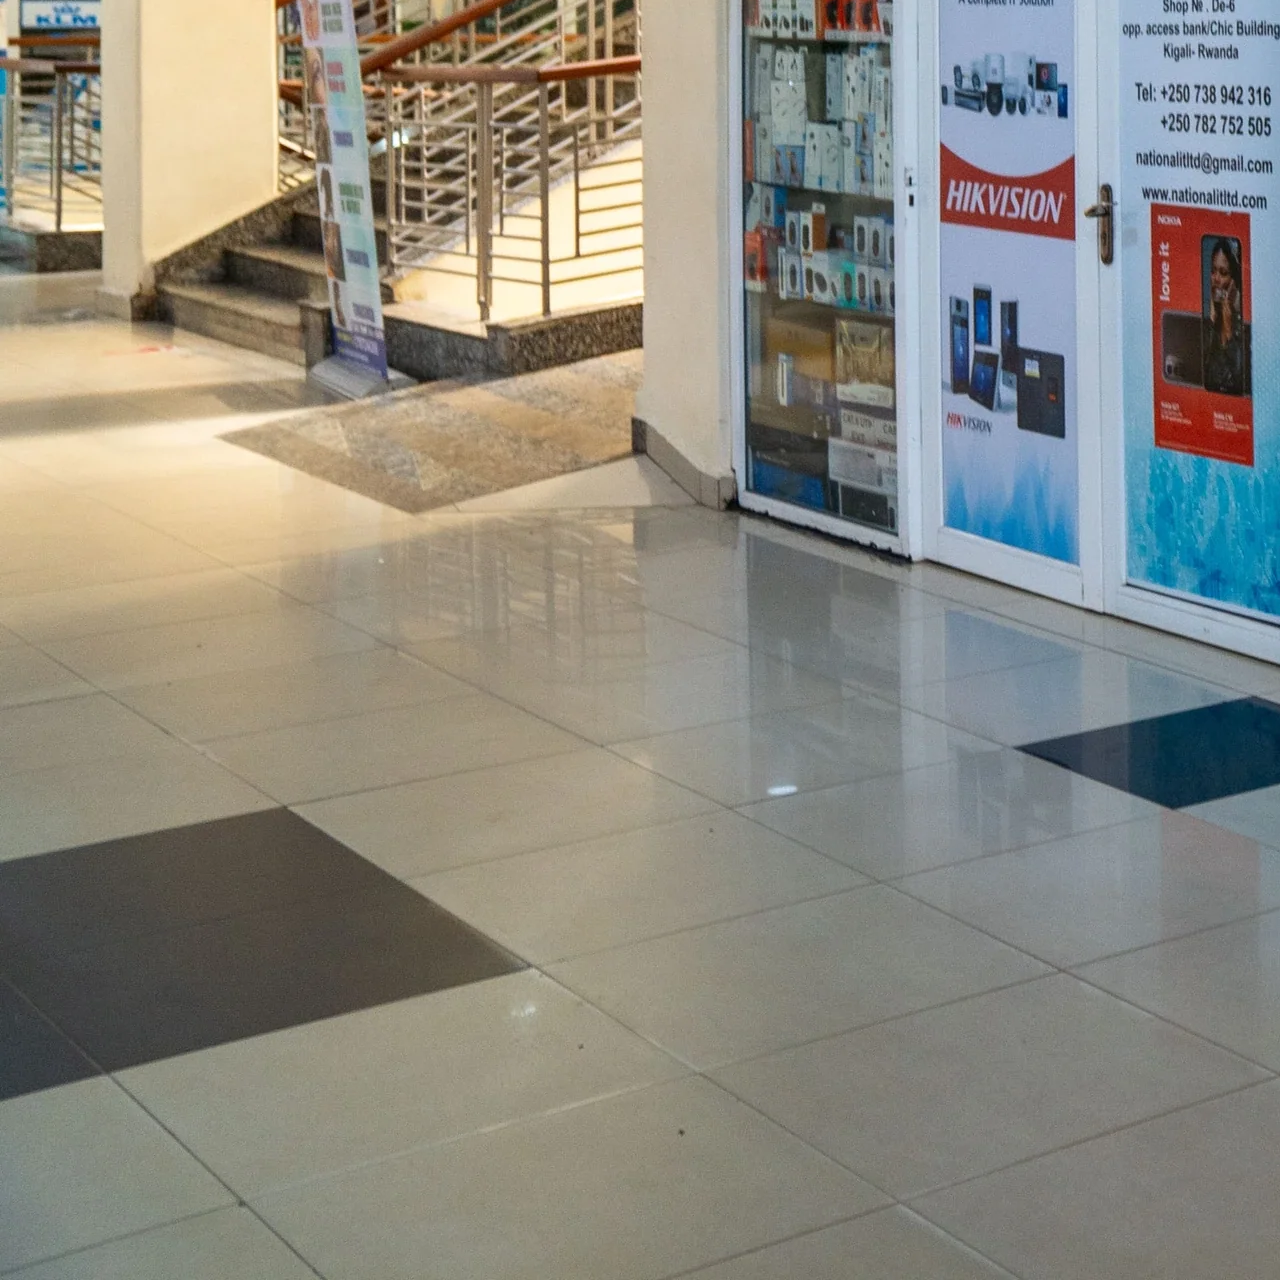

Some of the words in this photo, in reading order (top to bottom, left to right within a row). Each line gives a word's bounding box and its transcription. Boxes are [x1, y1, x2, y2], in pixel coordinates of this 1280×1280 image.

[1122, 23, 1144, 37] opp.
[1146, 22, 1180, 36] access
[1182, 20, 1233, 37] bank/Chic
[1163, 43, 1196, 62] Kigali-
[1197, 43, 1239, 61] Rwanda
[1135, 82, 1157, 103] Tel:
[1160, 84, 1191, 104] +250
[1193, 84, 1218, 105] 738
[1220, 85, 1245, 106] 942
[1247, 86, 1272, 107] 316
[1160, 113, 1191, 133] +250
[1193, 114, 1217, 135] 782
[1220, 115, 1245, 136] 752
[1247, 116, 1272, 137] 505
[1135, 150, 1274, 175] nationalitltd@gmail.com
[945, 180, 1063, 225] HIKVISION
[1141, 185, 1268, 210] www.nationalitltd.com
[1157, 214, 1182, 226] NOKIA
[1158, 241, 1170, 258] it
[1159, 261, 1171, 302] love
[946, 411, 993, 437] HIKVISION
